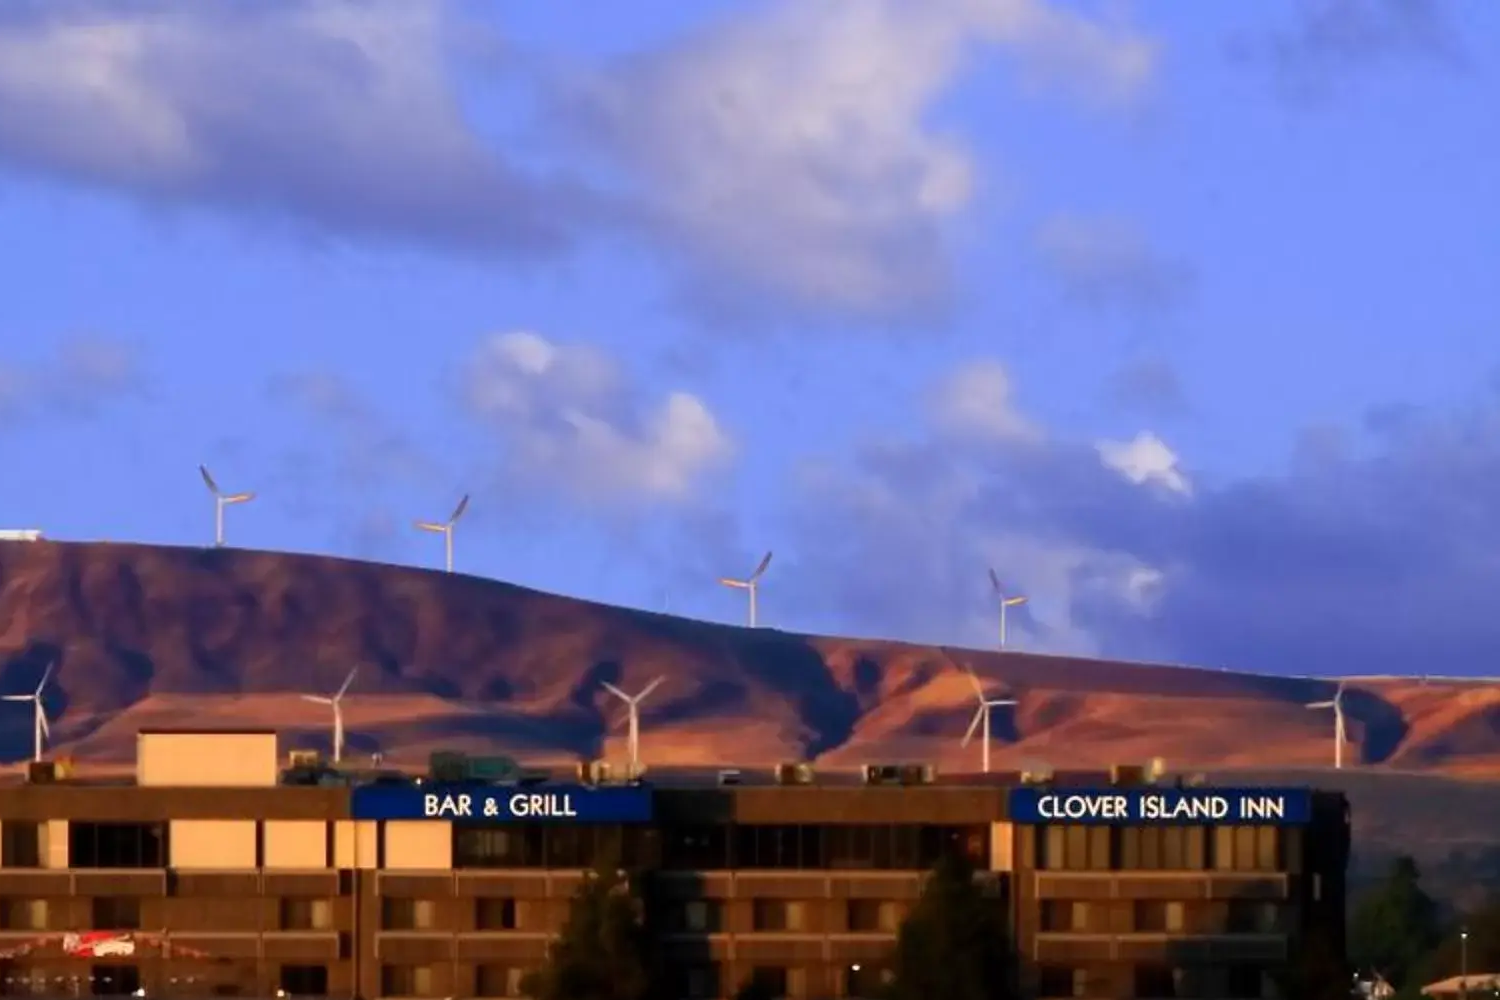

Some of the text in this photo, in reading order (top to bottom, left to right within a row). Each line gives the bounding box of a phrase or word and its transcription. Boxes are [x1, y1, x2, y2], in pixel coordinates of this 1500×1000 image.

[425, 794, 576, 816] BAR & GRILL
[1038, 796, 1283, 818] CLOVER ISLAND INN
